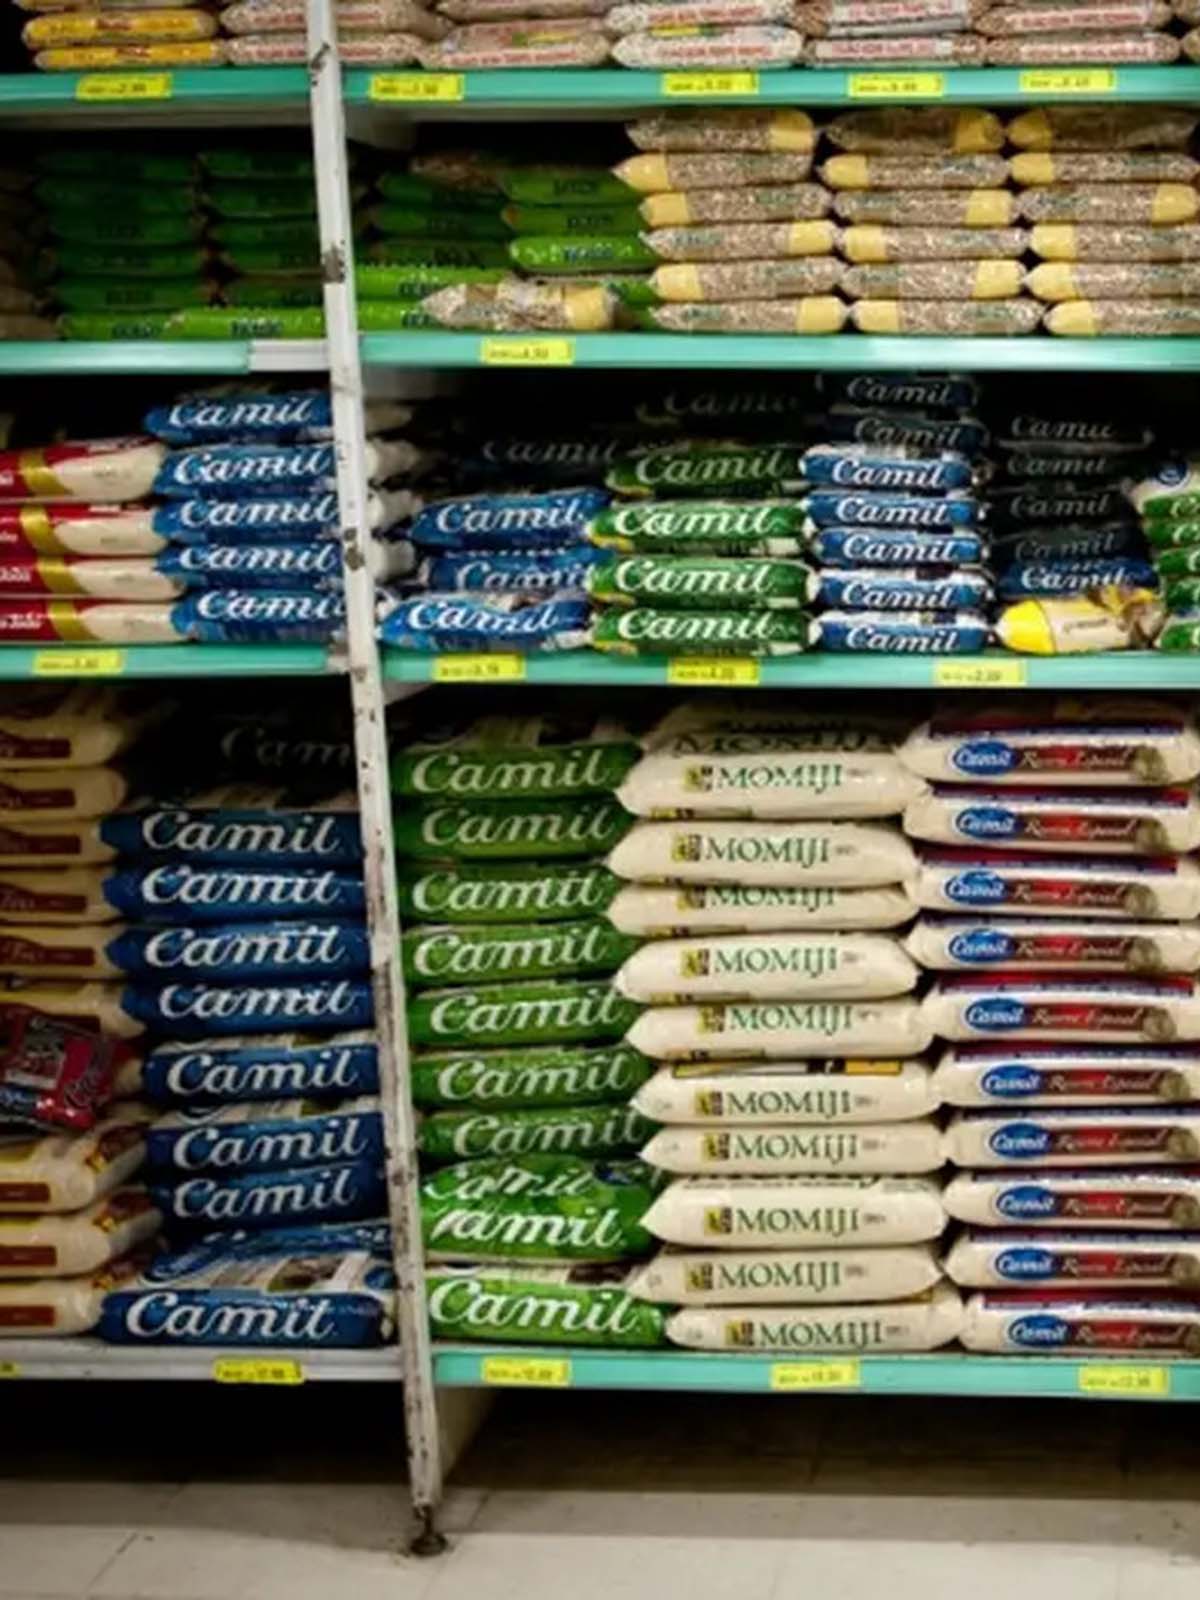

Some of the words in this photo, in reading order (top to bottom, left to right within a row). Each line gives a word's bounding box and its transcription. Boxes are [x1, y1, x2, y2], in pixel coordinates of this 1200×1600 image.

[168, 397, 313, 428] Camil
[854, 416, 961, 448] Camil
[173, 449, 331, 484] Camil
[636, 448, 788, 484] Camil
[832, 457, 944, 488] Camil
[180, 496, 338, 526] Camil
[436, 498, 585, 533] Camil
[614, 505, 773, 536] Camil
[836, 497, 949, 525] Camil
[180, 544, 338, 571] Camil
[843, 532, 958, 563] Camil
[615, 559, 773, 593] Camil
[842, 579, 954, 608] Camil
[407, 601, 560, 632] Camil
[618, 610, 777, 640] Camil
[846, 622, 961, 651] Camil
[411, 750, 610, 793] Camil
[717, 764, 843, 793] MOMIJI
[141, 811, 340, 854] Camil
[422, 804, 616, 845] Camil
[707, 837, 830, 868] MOMIJI
[141, 864, 343, 905] Camil
[411, 871, 605, 912] Camil
[144, 926, 346, 966] Camil
[414, 927, 606, 976] Camil
[715, 947, 838, 978] MOMIJI
[159, 980, 356, 1019] Camil
[430, 989, 624, 1035] Camil
[731, 1005, 852, 1036] MOMIJI
[167, 1050, 358, 1095] Camil
[438, 1053, 633, 1099] Camil
[728, 1090, 851, 1119] MOMIJI
[173, 1118, 368, 1170] Camil
[454, 1109, 646, 1156] Camil
[735, 1134, 857, 1164] MOMIJI
[174, 1169, 358, 1220] Camil
[737, 1208, 860, 1237] MOMIJI
[719, 1262, 841, 1292] MOMIJI
[126, 1292, 335, 1339] Camil
[429, 1279, 640, 1334] Camil
[759, 1322, 882, 1350] MOMIJI
